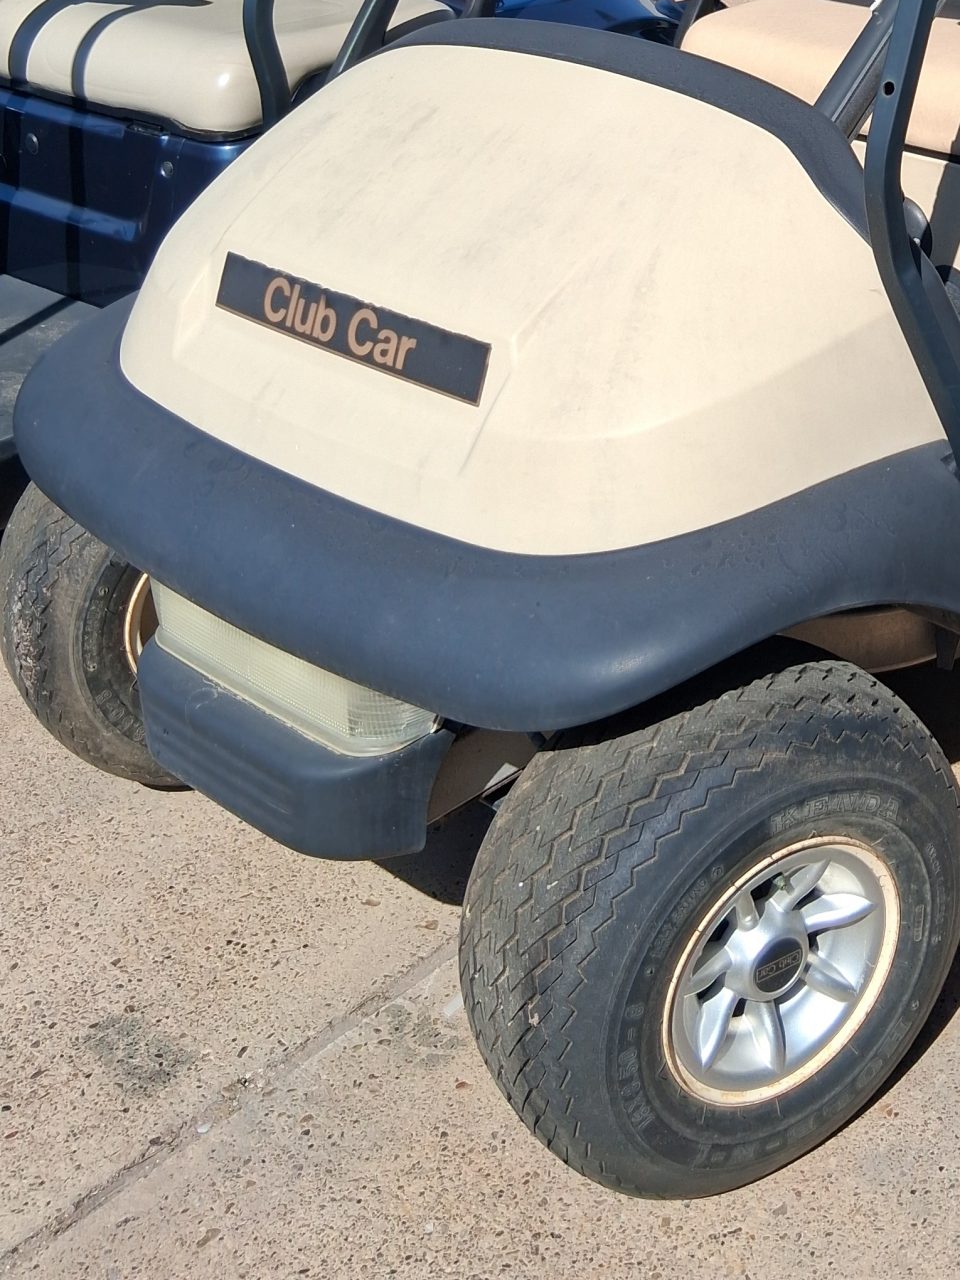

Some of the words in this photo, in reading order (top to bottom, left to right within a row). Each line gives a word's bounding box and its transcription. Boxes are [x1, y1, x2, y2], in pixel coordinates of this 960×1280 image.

[263, 276, 337, 343] Club
[347, 307, 418, 371] Car
[769, 792, 900, 837] KENDA
